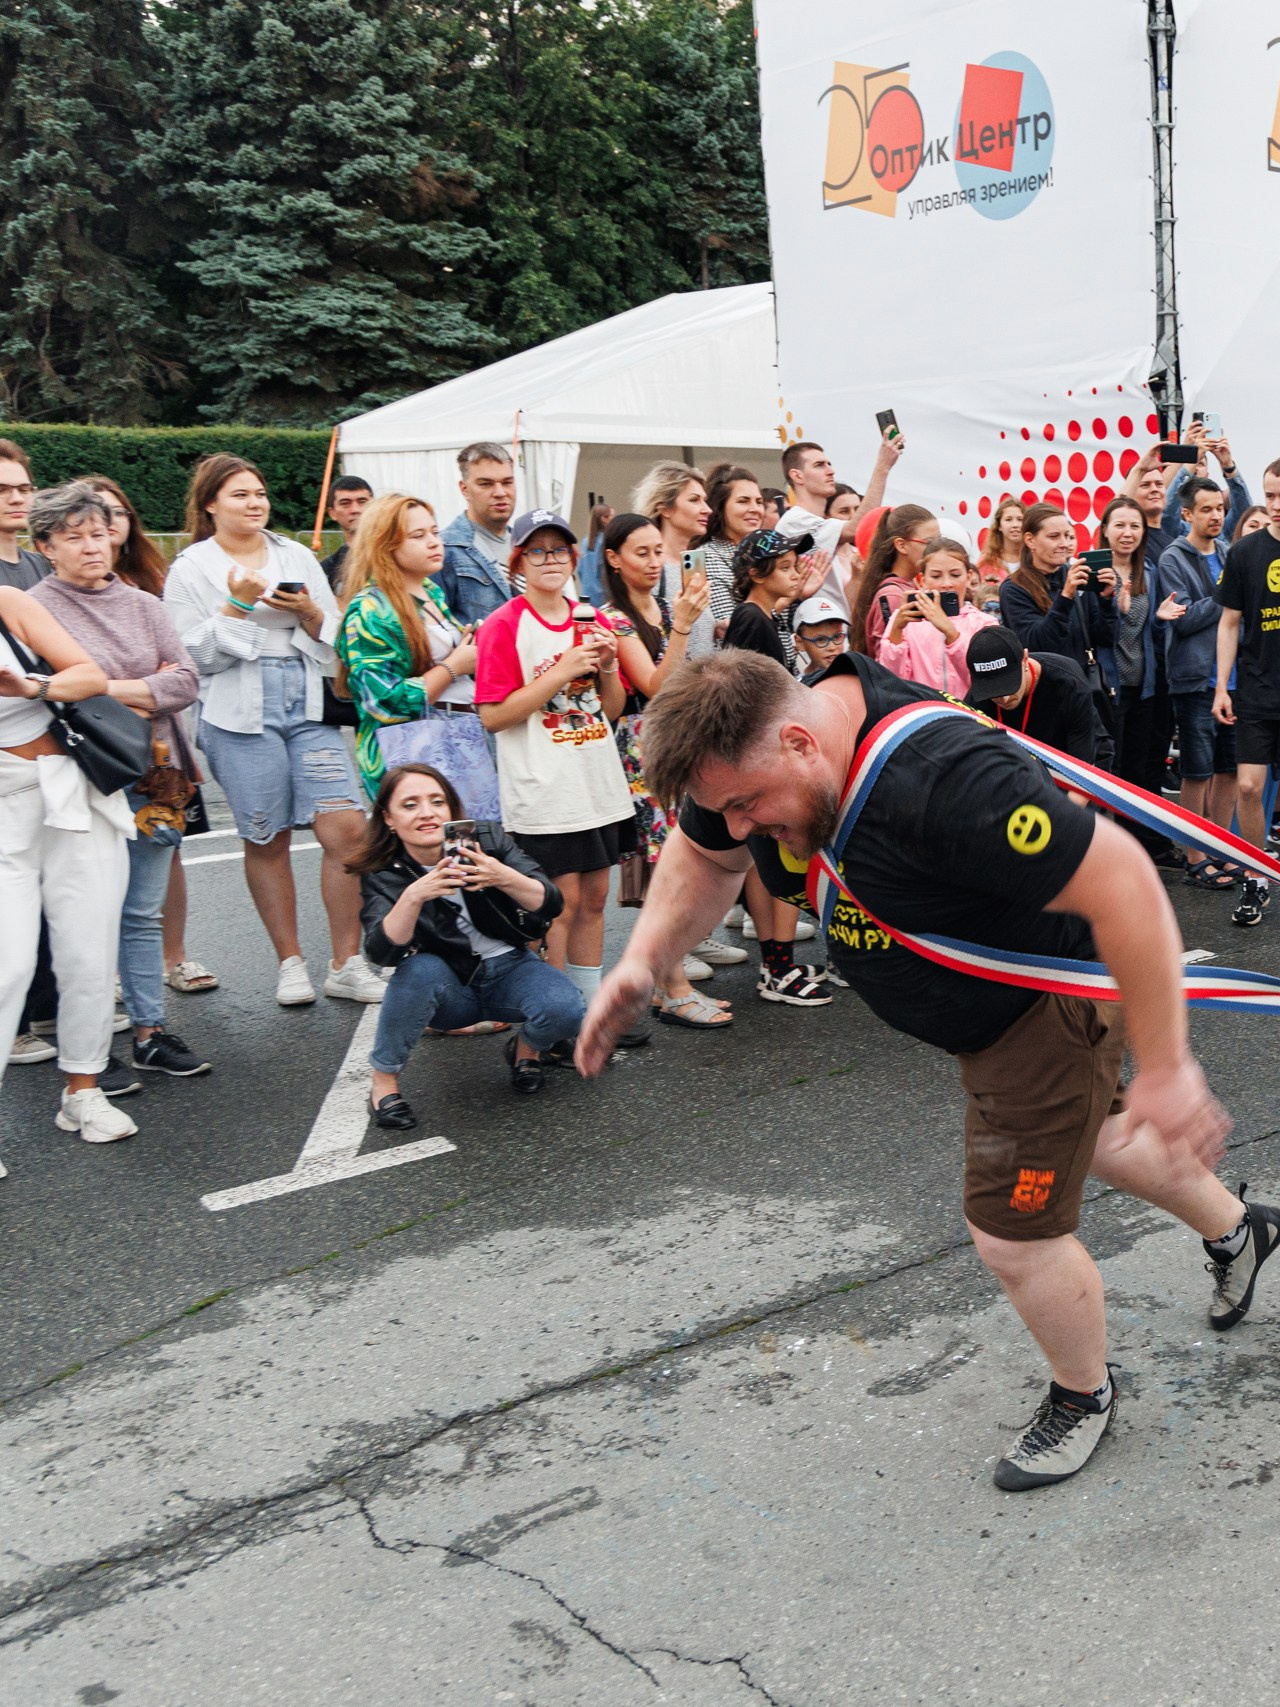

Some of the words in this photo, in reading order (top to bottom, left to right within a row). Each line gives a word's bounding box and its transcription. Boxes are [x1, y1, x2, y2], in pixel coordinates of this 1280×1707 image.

[870, 135, 950, 180] Оптик
[957, 111, 1052, 160] Центр
[907, 186, 977, 220] управляя
[980, 166, 1055, 202] зрением!
